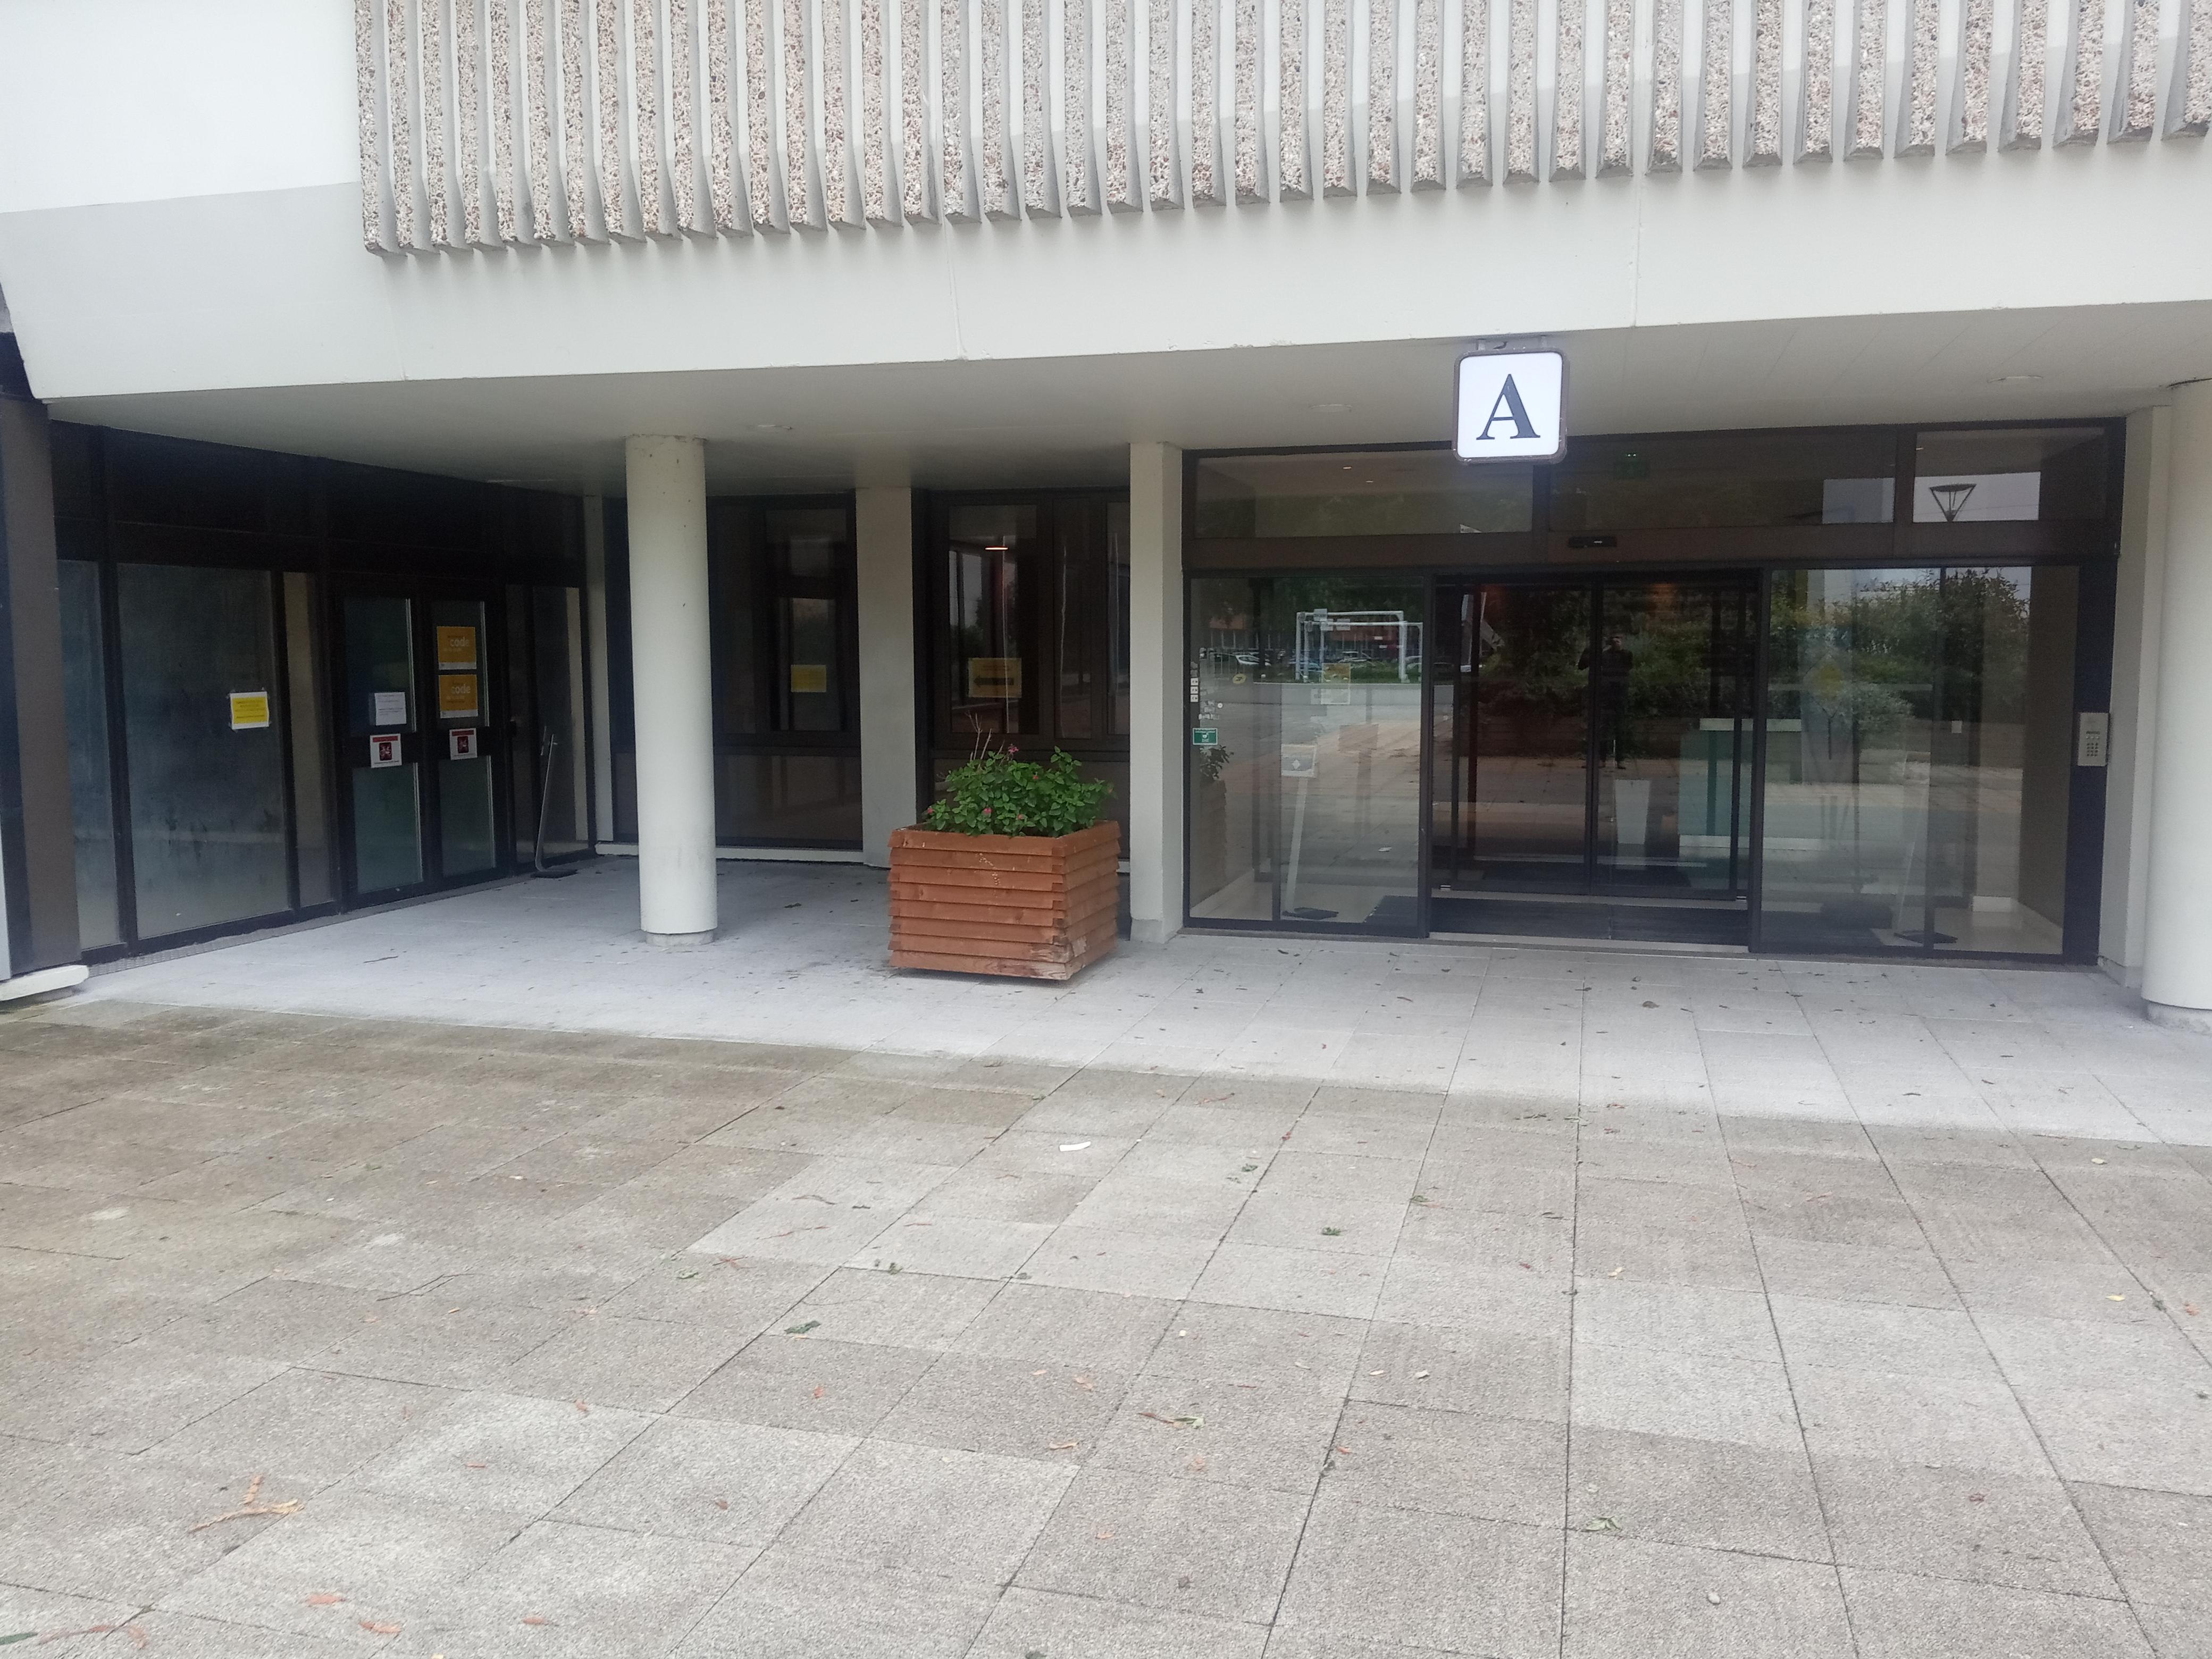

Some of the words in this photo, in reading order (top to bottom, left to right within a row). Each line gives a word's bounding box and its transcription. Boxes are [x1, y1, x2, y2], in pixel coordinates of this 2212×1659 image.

[1476, 373, 1541, 440] A
[450, 636, 470, 647] code
[450, 683, 471, 694] code
